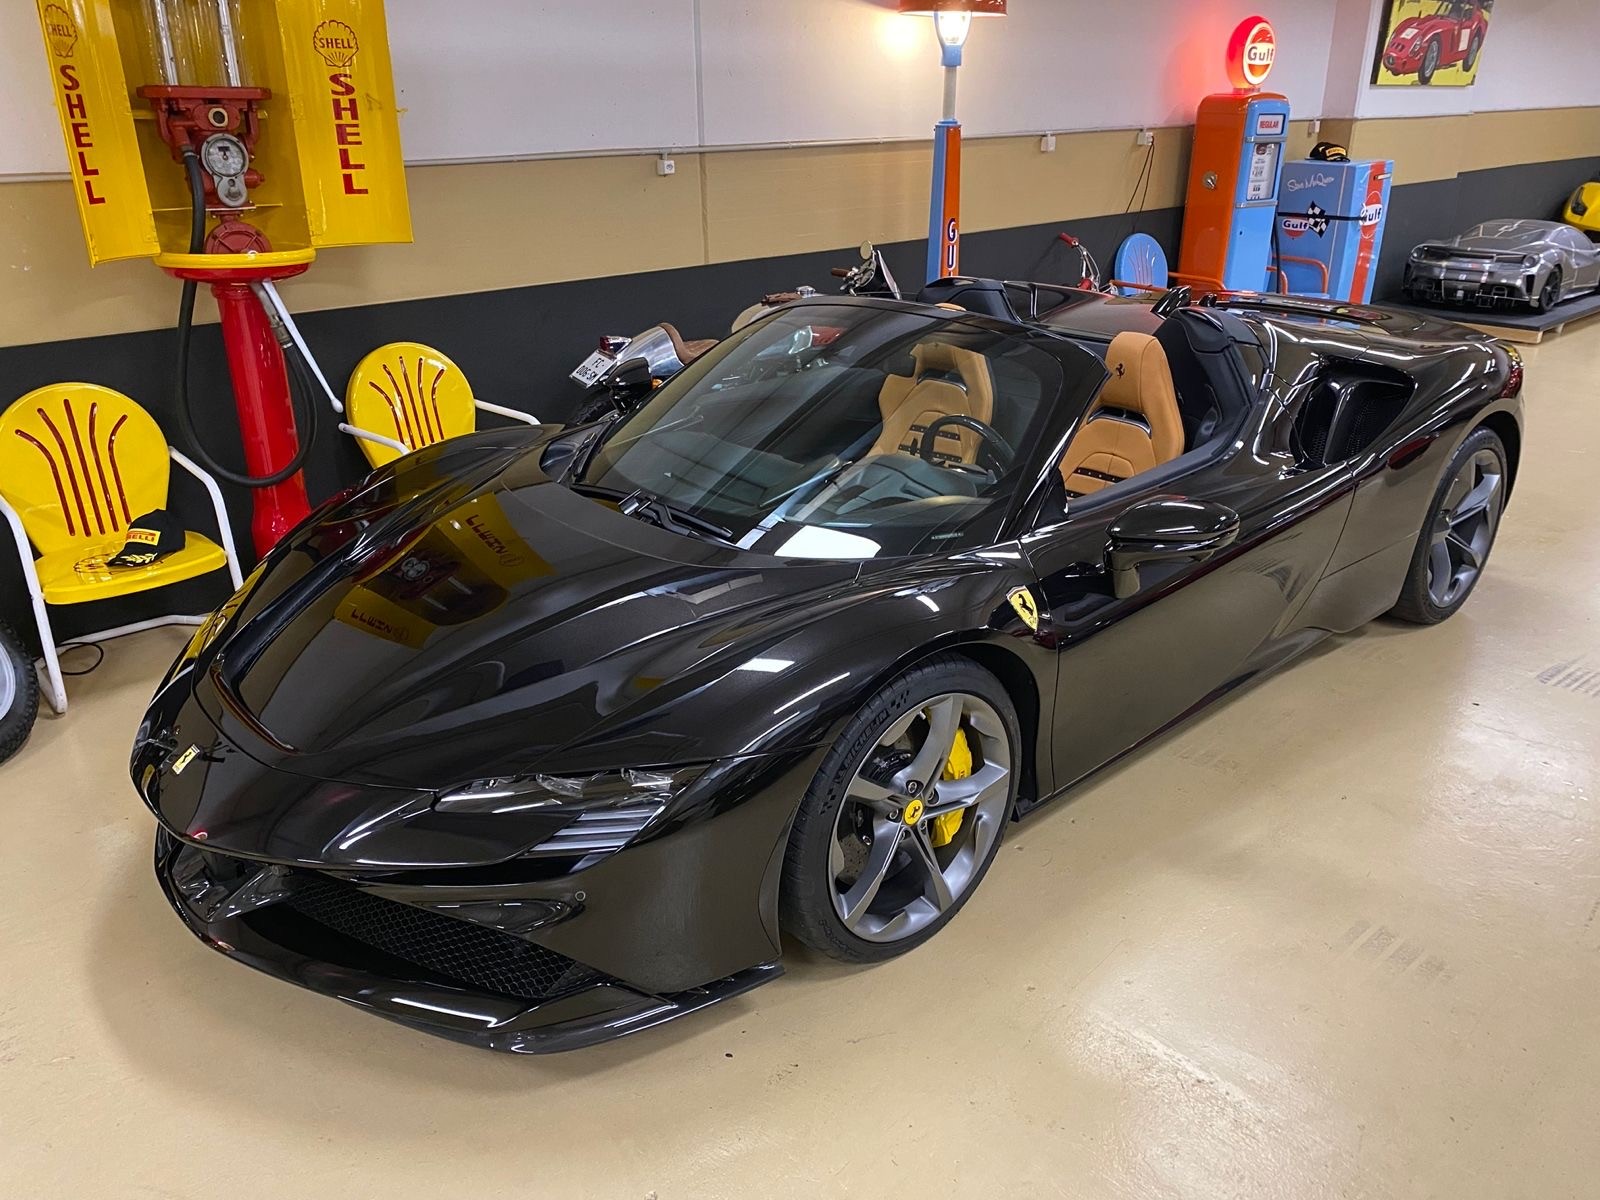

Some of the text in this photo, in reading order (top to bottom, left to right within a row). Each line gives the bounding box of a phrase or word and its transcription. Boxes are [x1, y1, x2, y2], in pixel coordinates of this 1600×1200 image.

[49, 24, 72, 37] HELL
[319, 38, 353, 49] SHELL
[1247, 46, 1274, 61] Gulf
[1260, 121, 1279, 129] REGULAR
[59, 65, 106, 205] SHELL
[328, 73, 368, 195] SHELL
[1364, 207, 1381, 221] ulf
[1283, 219, 1309, 230] Gulf
[947, 217, 957, 277] GU
[842, 707, 891, 768] MICHELIN
